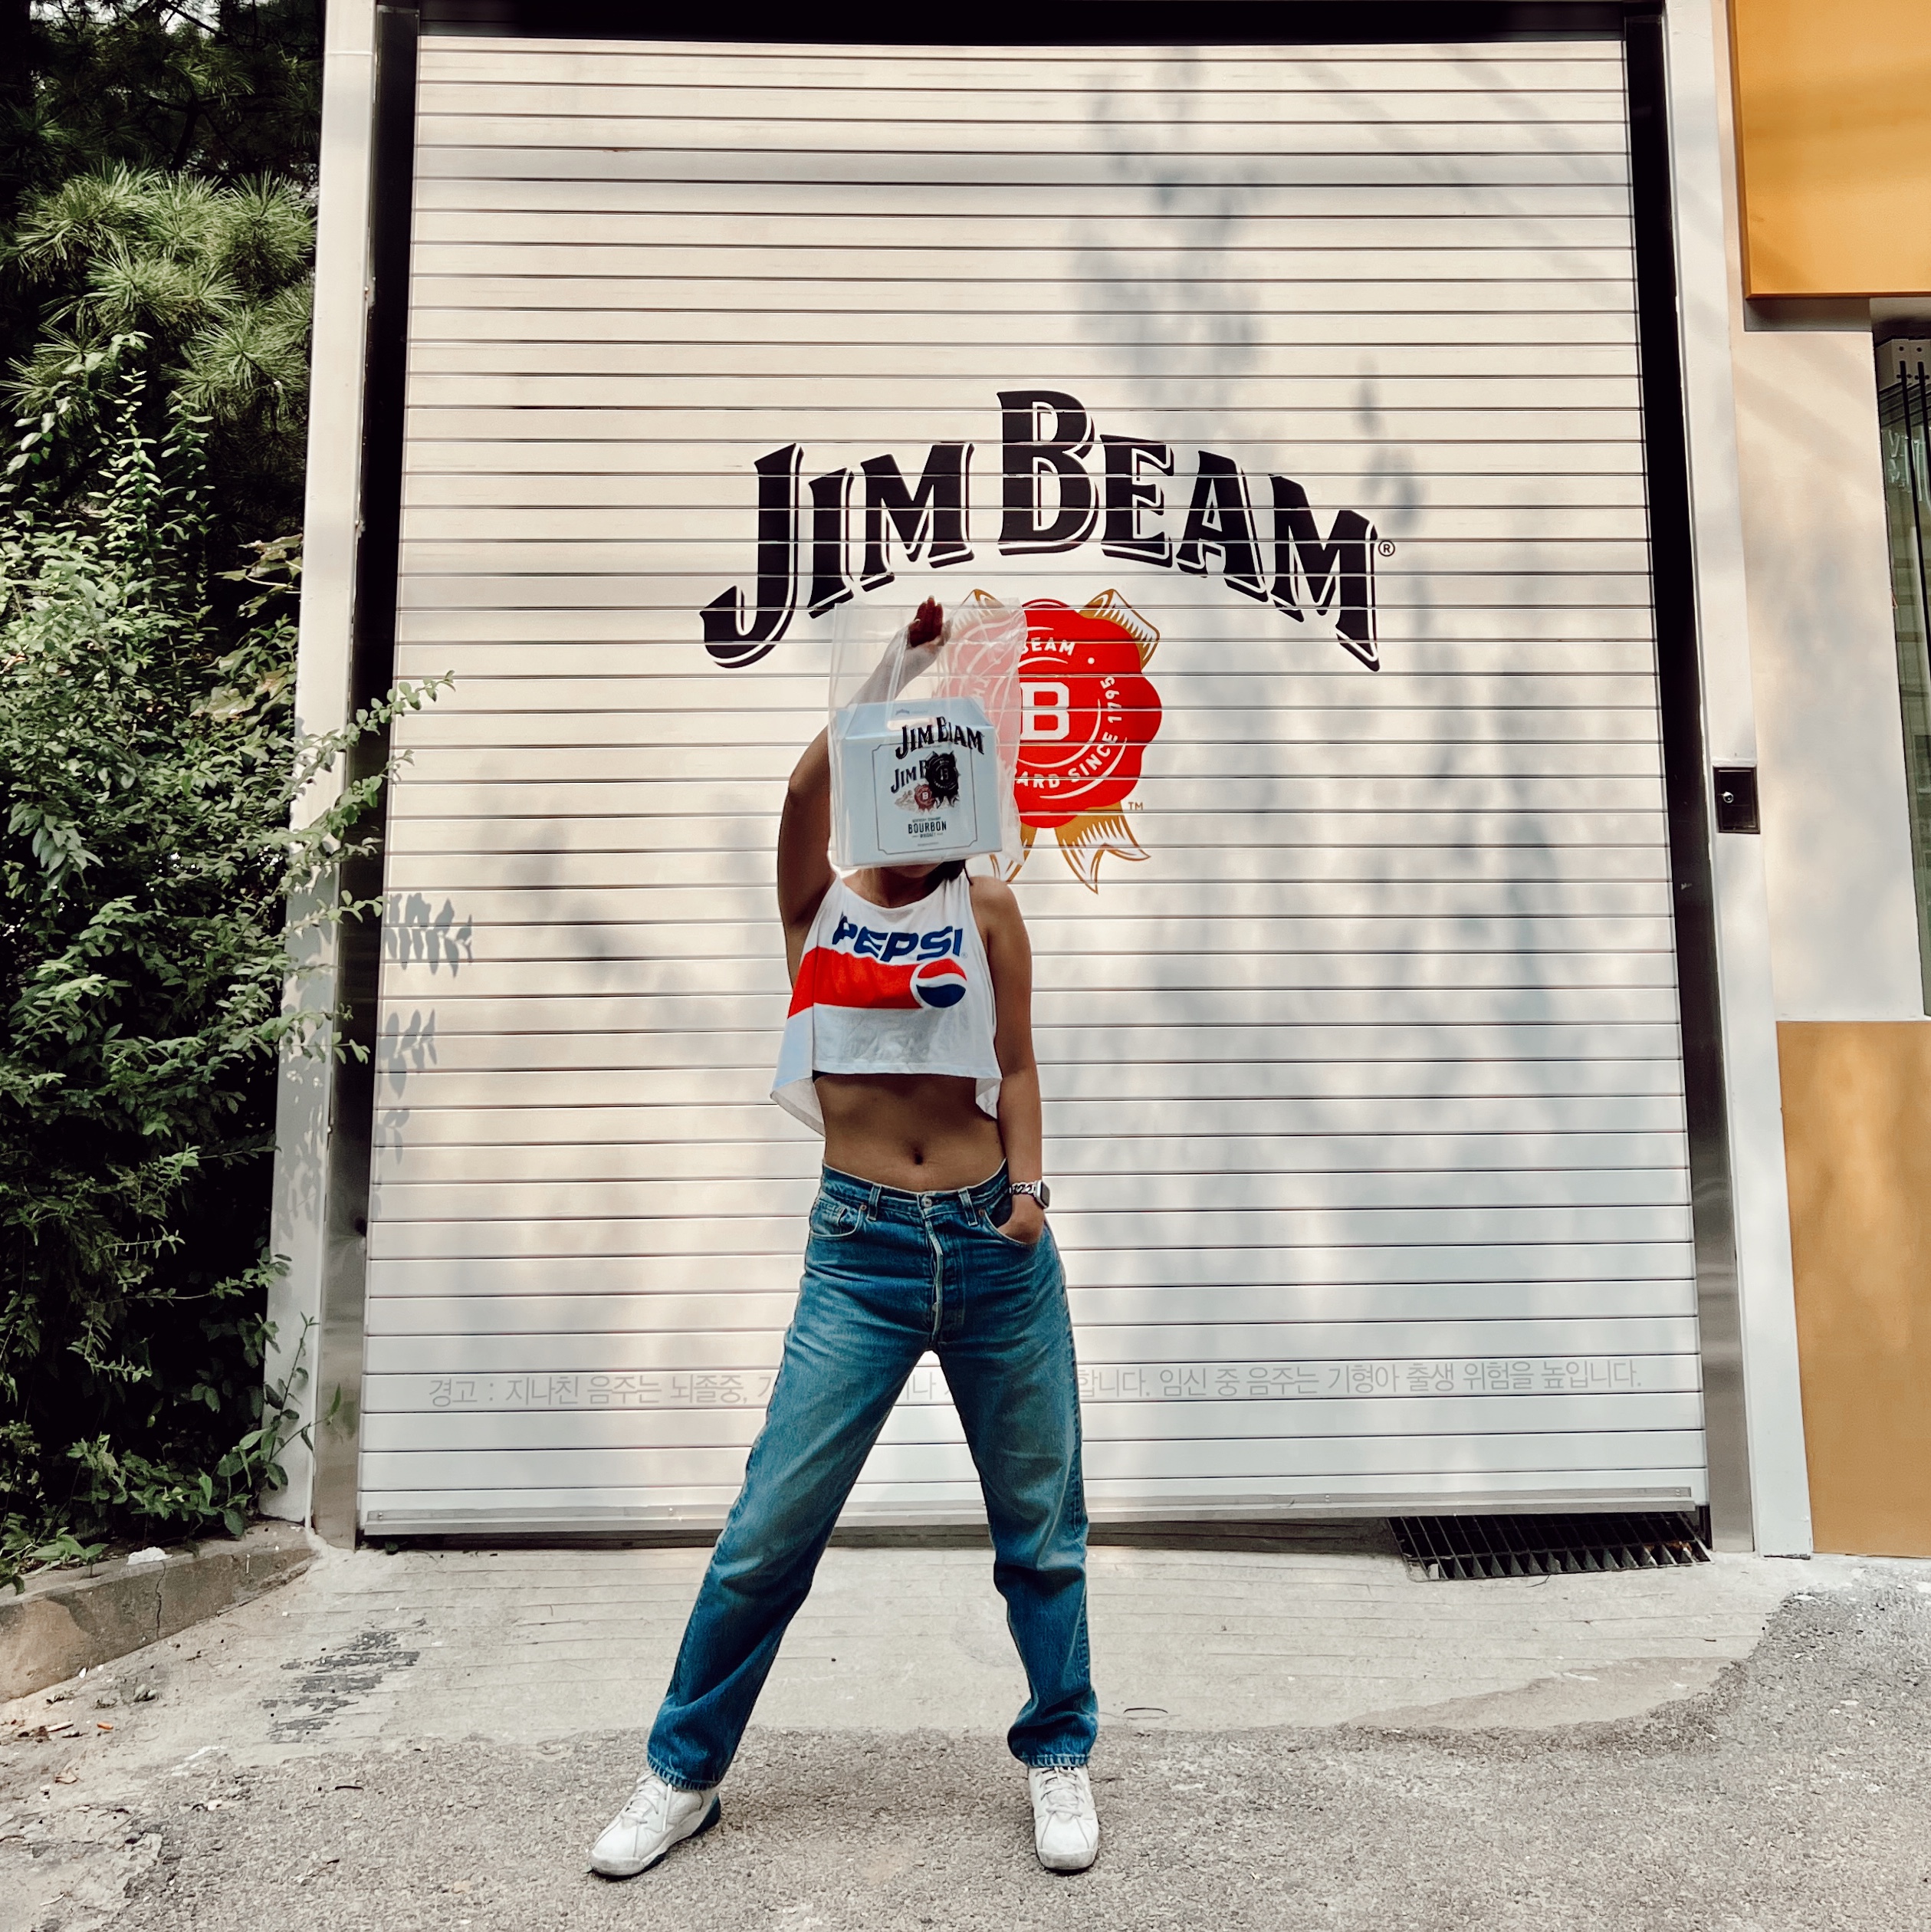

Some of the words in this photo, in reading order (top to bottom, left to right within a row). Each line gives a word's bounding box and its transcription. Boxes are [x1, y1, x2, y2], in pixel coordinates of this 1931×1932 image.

[699, 442, 974, 669] JIM
[996, 389, 1378, 672] BEAM
[1020, 682, 1070, 741] B
[1067, 731, 1118, 783] SINCE
[1100, 676, 1122, 723] 1795
[895, 724, 934, 759] JIM
[891, 766, 917, 794] JIM
[908, 820, 947, 834] BOURBON
[832, 915, 964, 963] PEPSI
[428, 1377, 478, 1408] 경고
[504, 1375, 579, 1406] 지나친
[586, 1375, 662, 1405] 음주는
[671, 1374, 748, 1405] 뇌졸중,
[1160, 1368, 1207, 1397] 임신
[1246, 1366, 1320, 1395] 음주는
[1328, 1365, 1400, 1394] 기형아
[1406, 1362, 1455, 1392] 출생
[1463, 1361, 1534, 1391] 위험을
[1541, 1359, 1643, 1390] 높입니다.
